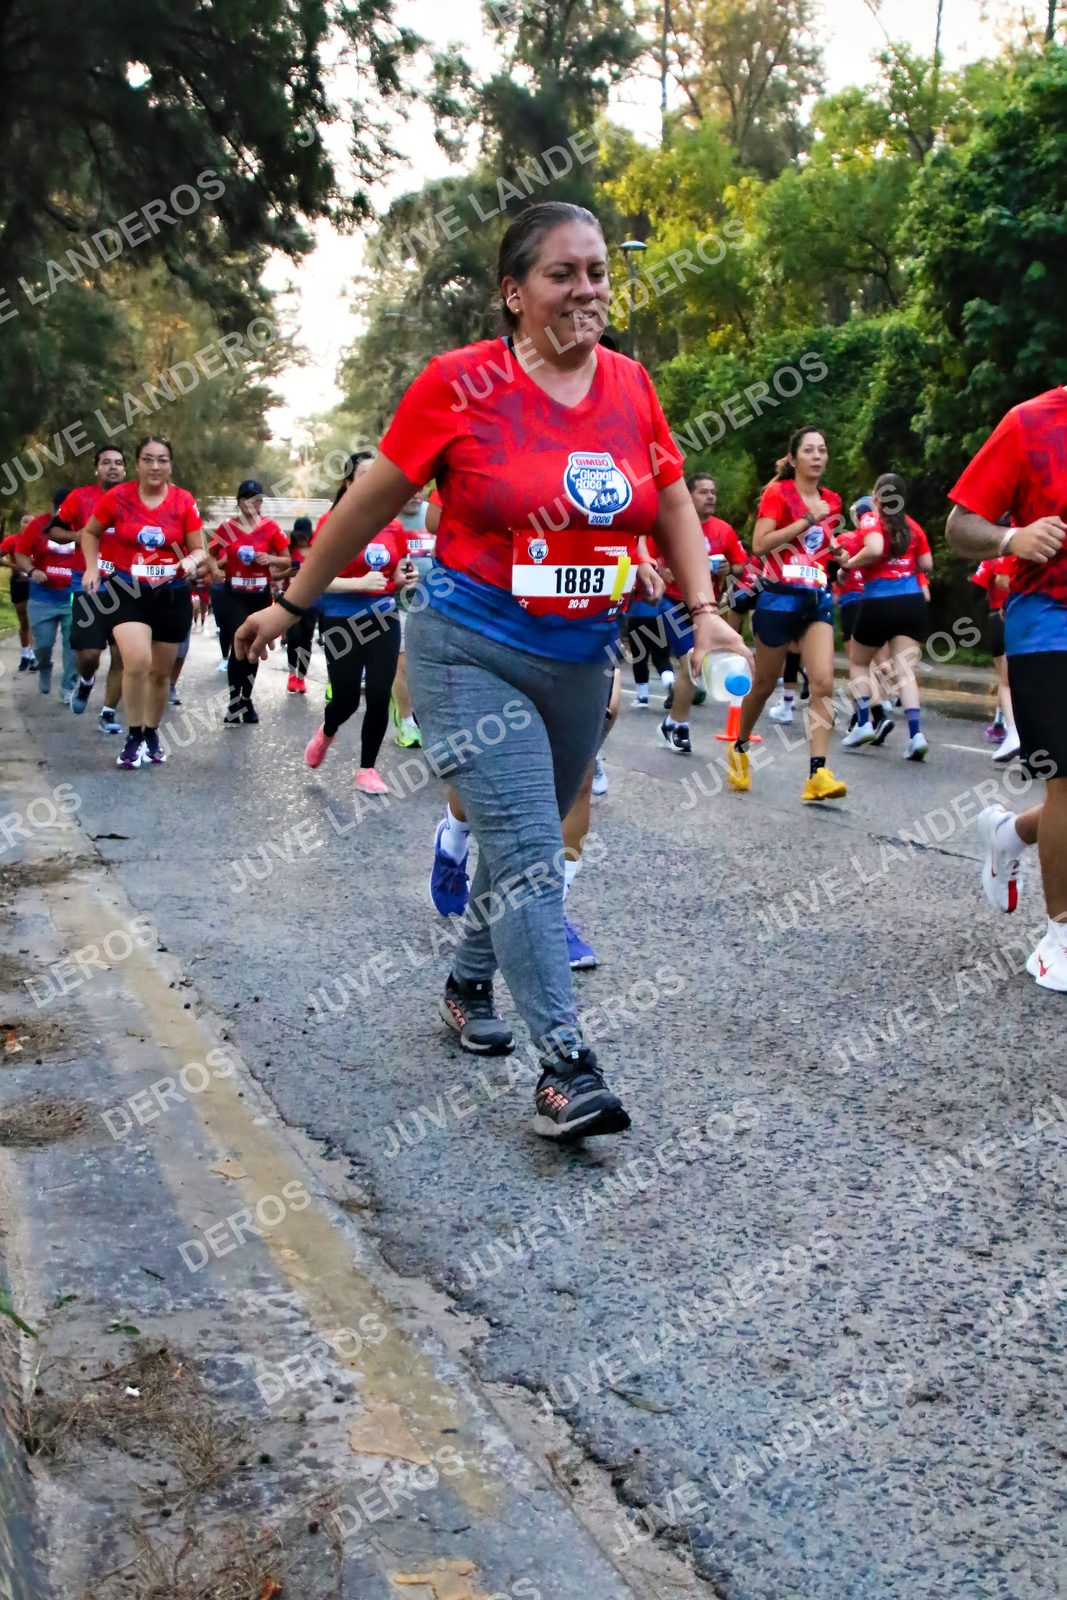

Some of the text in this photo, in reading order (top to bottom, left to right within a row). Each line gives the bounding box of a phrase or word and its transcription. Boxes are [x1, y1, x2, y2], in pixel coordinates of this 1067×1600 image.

[575, 458, 609, 467] BIMBO
[580, 470, 613, 481] Global
[575, 478, 602, 490] Race
[590, 515, 611, 524] 2026
[554, 567, 605, 594] 1883
